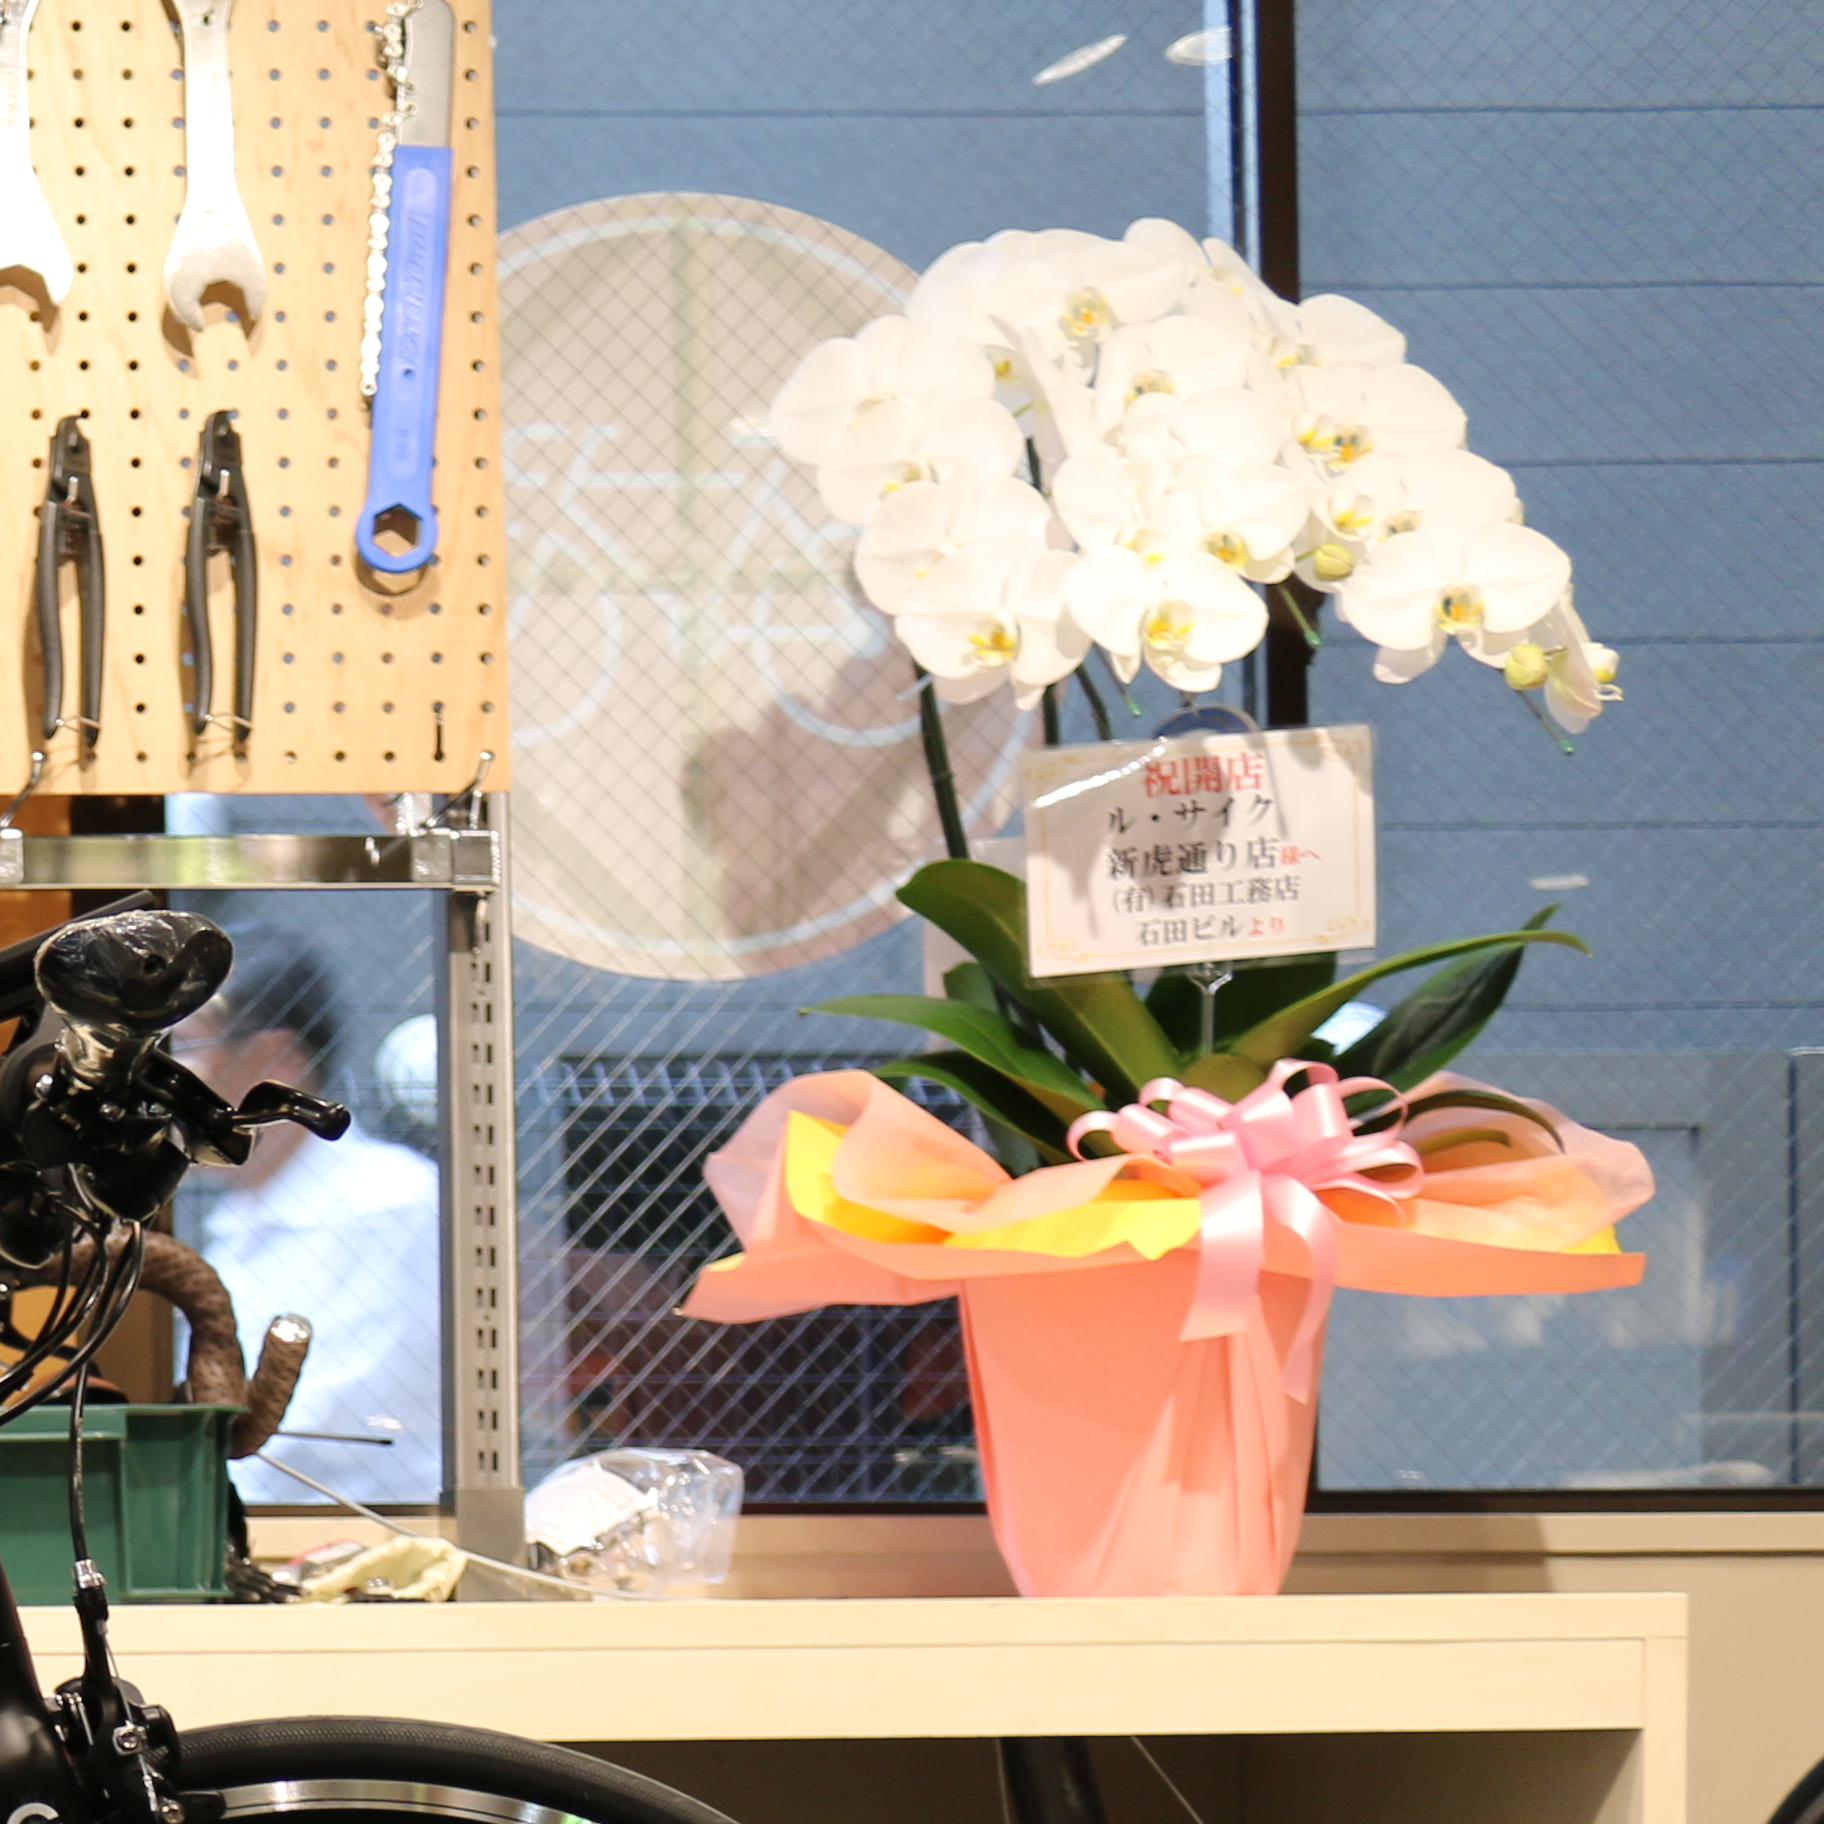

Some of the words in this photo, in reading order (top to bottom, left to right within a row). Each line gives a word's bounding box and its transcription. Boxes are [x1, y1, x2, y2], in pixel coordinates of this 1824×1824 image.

[1143, 751, 1265, 799] 祝開店
[1108, 795, 1275, 836] ル・サイク
